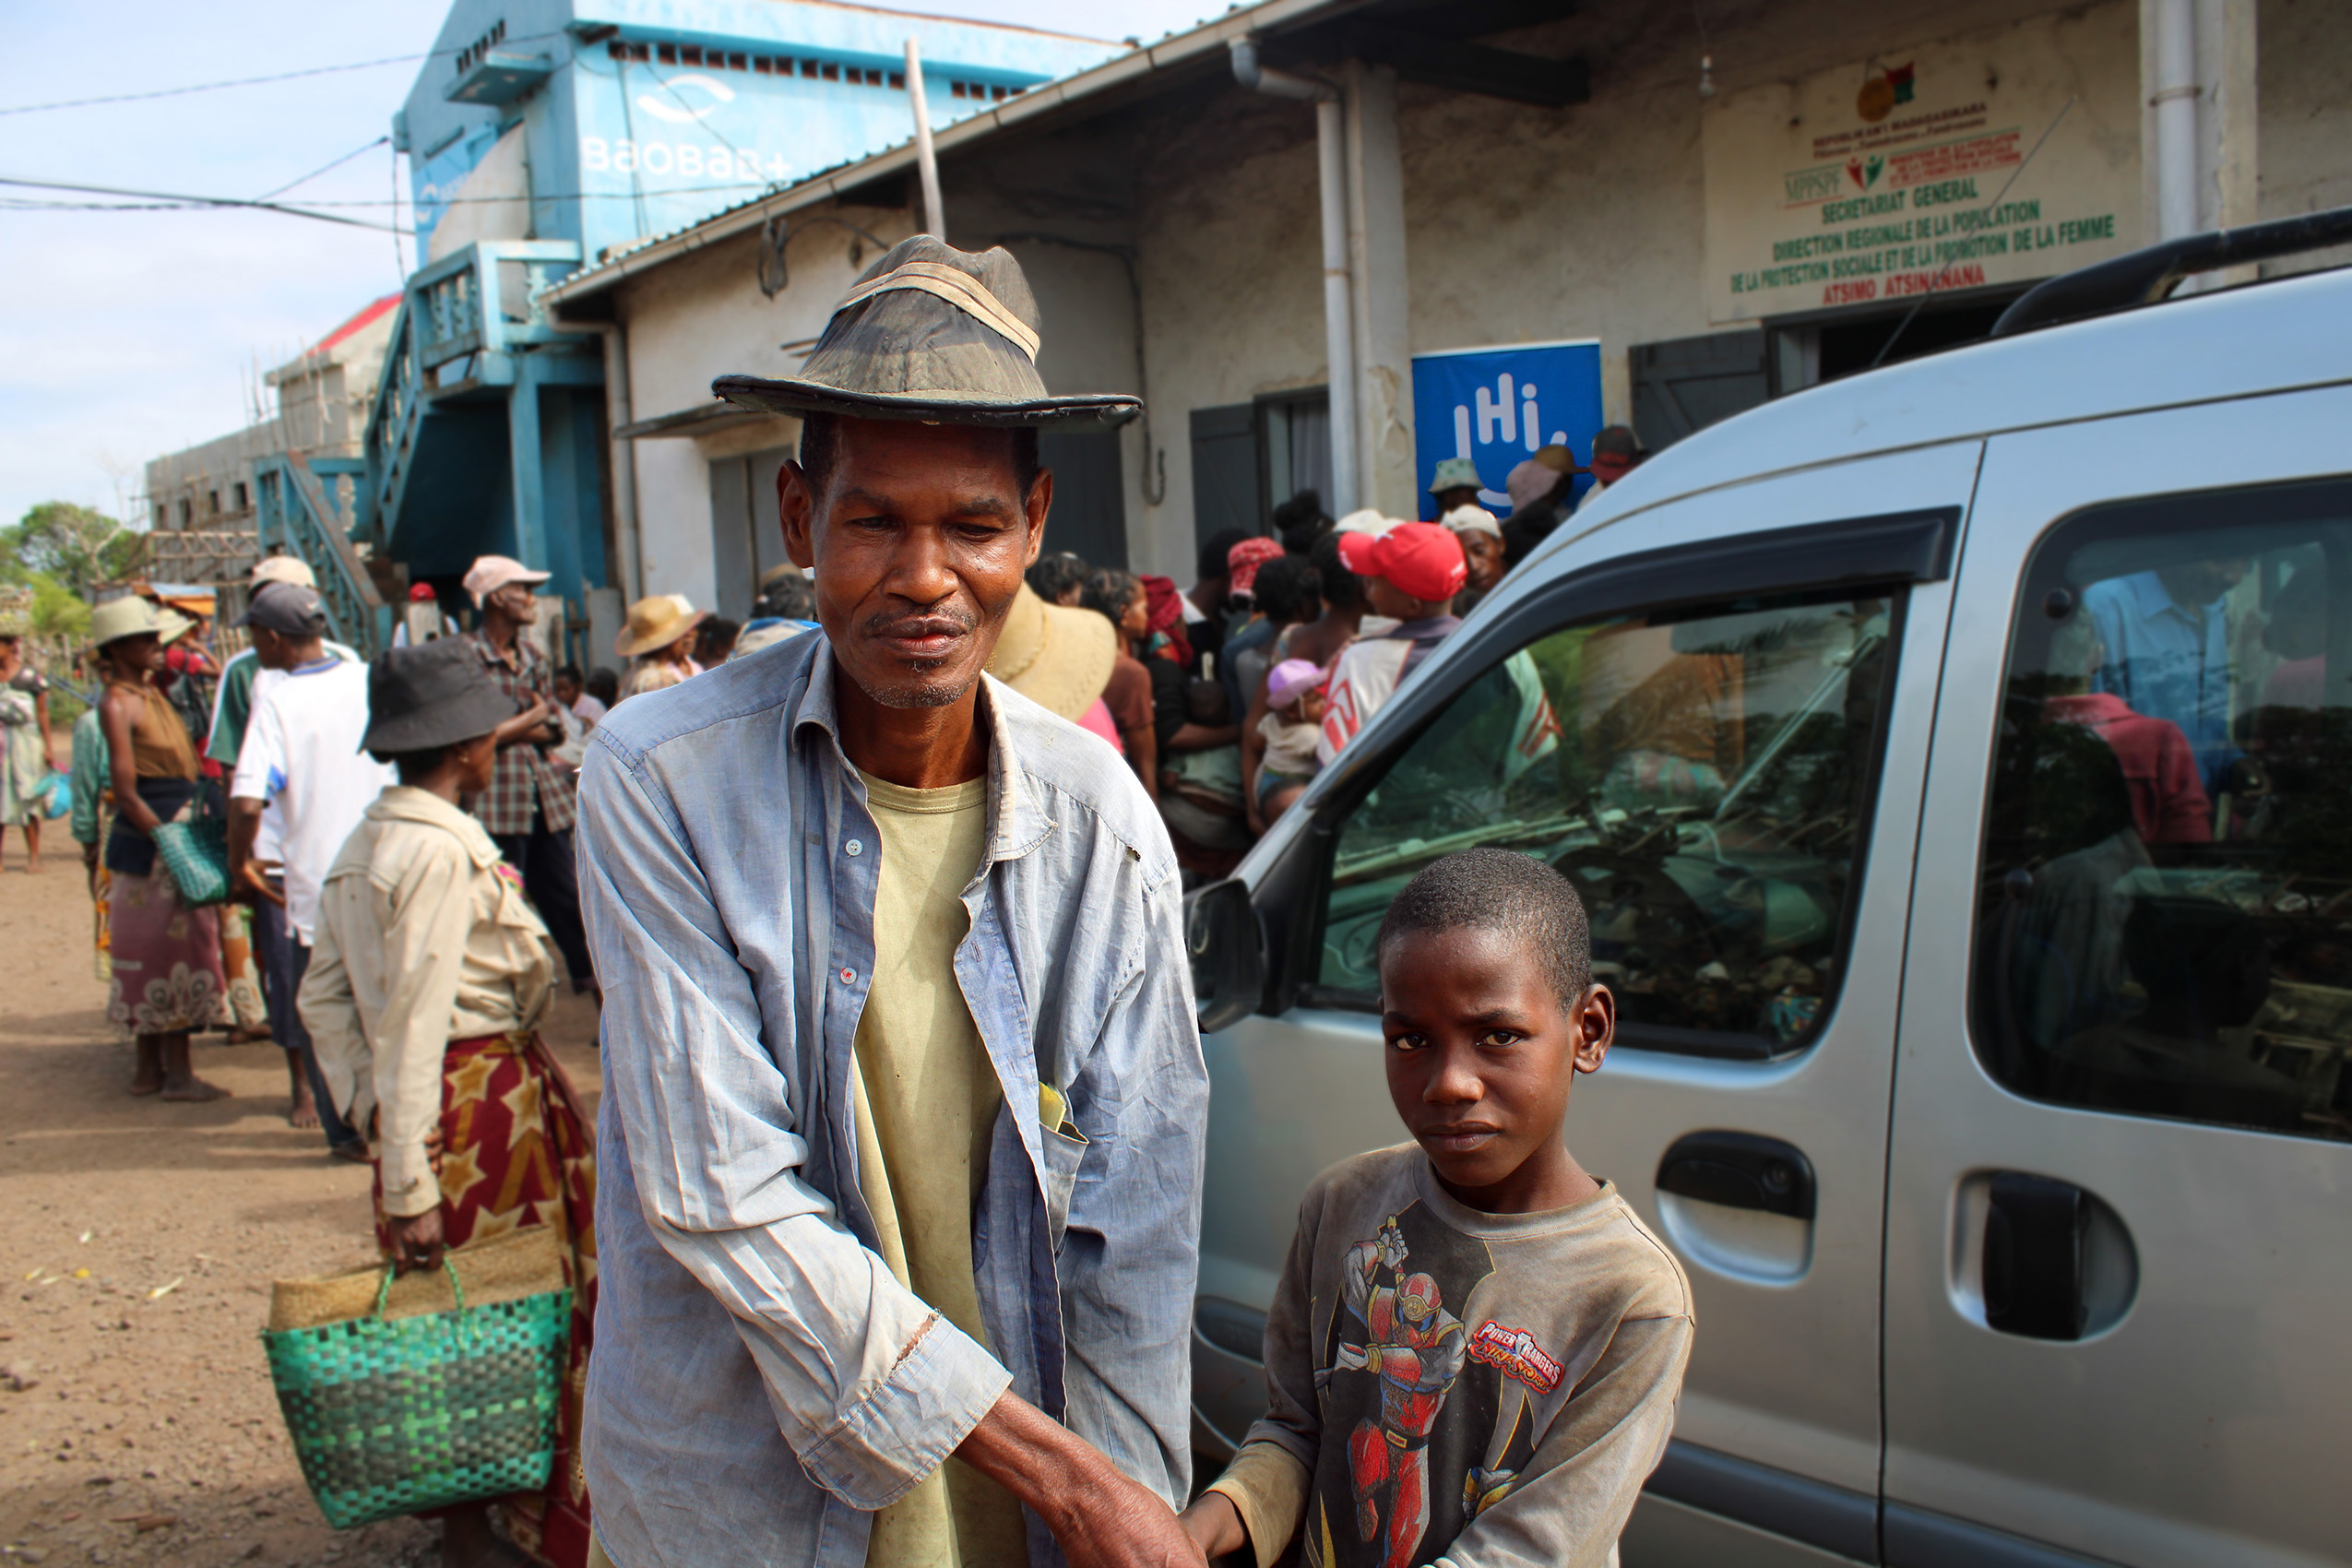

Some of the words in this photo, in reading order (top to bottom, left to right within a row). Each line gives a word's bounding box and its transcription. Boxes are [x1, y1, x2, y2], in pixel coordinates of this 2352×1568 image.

[1773, 232, 1843, 262] DIRECTION
[1847, 223, 1912, 250] REGIONALE
[1916, 220, 1931, 241] DE
[1936, 217, 1951, 236] LA
[1953, 200, 2039, 232] POPULATION
[1822, 190, 1906, 225] SECRETARIAT
[1913, 178, 1978, 209] GENERAL
[1731, 274, 1743, 293] DE
[1746, 271, 1759, 291] LA
[1762, 263, 1830, 289] PROTECTION
[1832, 254, 1883, 279] SOCIALE
[1885, 248, 1899, 270] ET
[1901, 248, 1914, 268] DE
[1918, 244, 1934, 265] LA
[1936, 234, 2007, 264] PROMOTION
[2013, 229, 2033, 252] DE
[2036, 224, 2055, 248] LA
[2059, 214, 2115, 244] FEMME
[1823, 279, 1876, 305] ATSIMO
[1885, 263, 1985, 297] ATSINANANA
[1476, 372, 1540, 453] Hi
[1477, 1323, 1517, 1348] POWER
[1519, 1340, 1561, 1386] RANGERS
